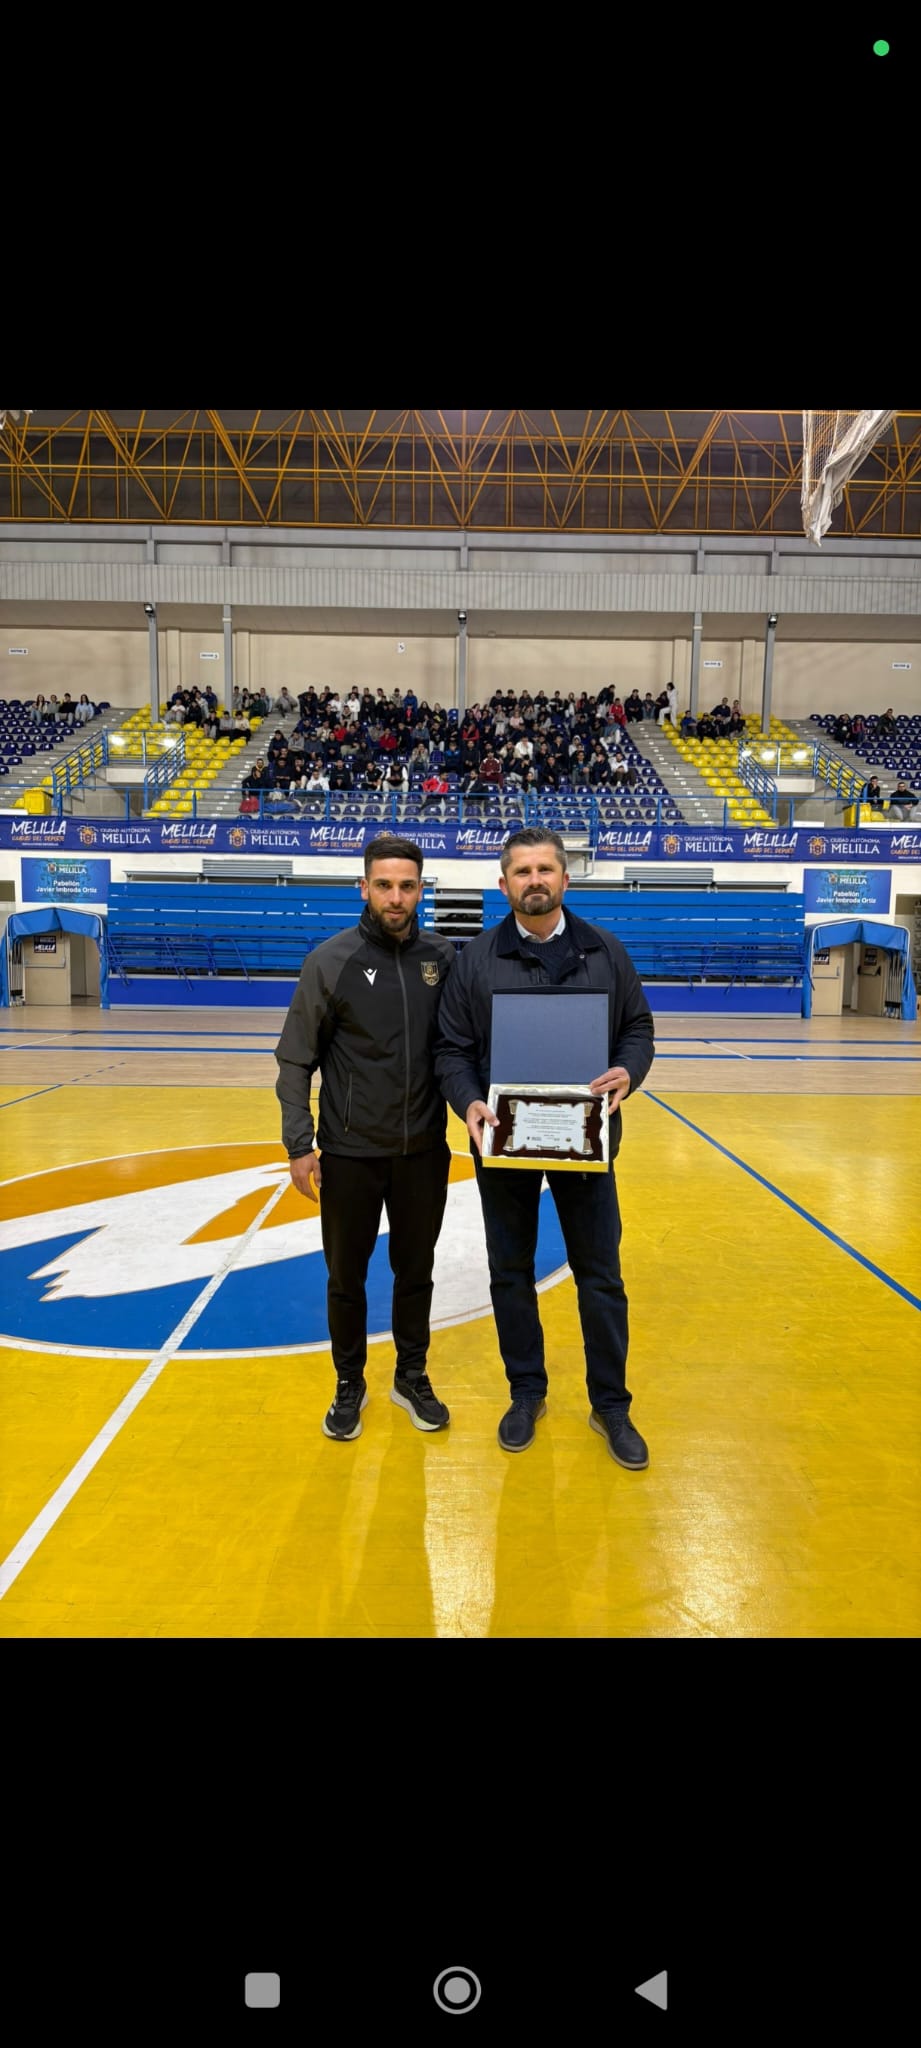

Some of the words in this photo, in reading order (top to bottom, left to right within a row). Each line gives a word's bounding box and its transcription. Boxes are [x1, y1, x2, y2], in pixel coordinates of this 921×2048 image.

[11, 820, 67, 835] MELILLA
[161, 824, 217, 838] MELILLA
[310, 826, 365, 841] MELILLA
[102, 833, 151, 844] MELILLA
[251, 835, 300, 846] MELILLA
[456, 829, 510, 844] MELILLA
[598, 831, 652, 846] MELILLA
[743, 832, 798, 847] MELILLA
[685, 841, 734, 852] MELILLA
[831, 844, 880, 854] MELILLA
